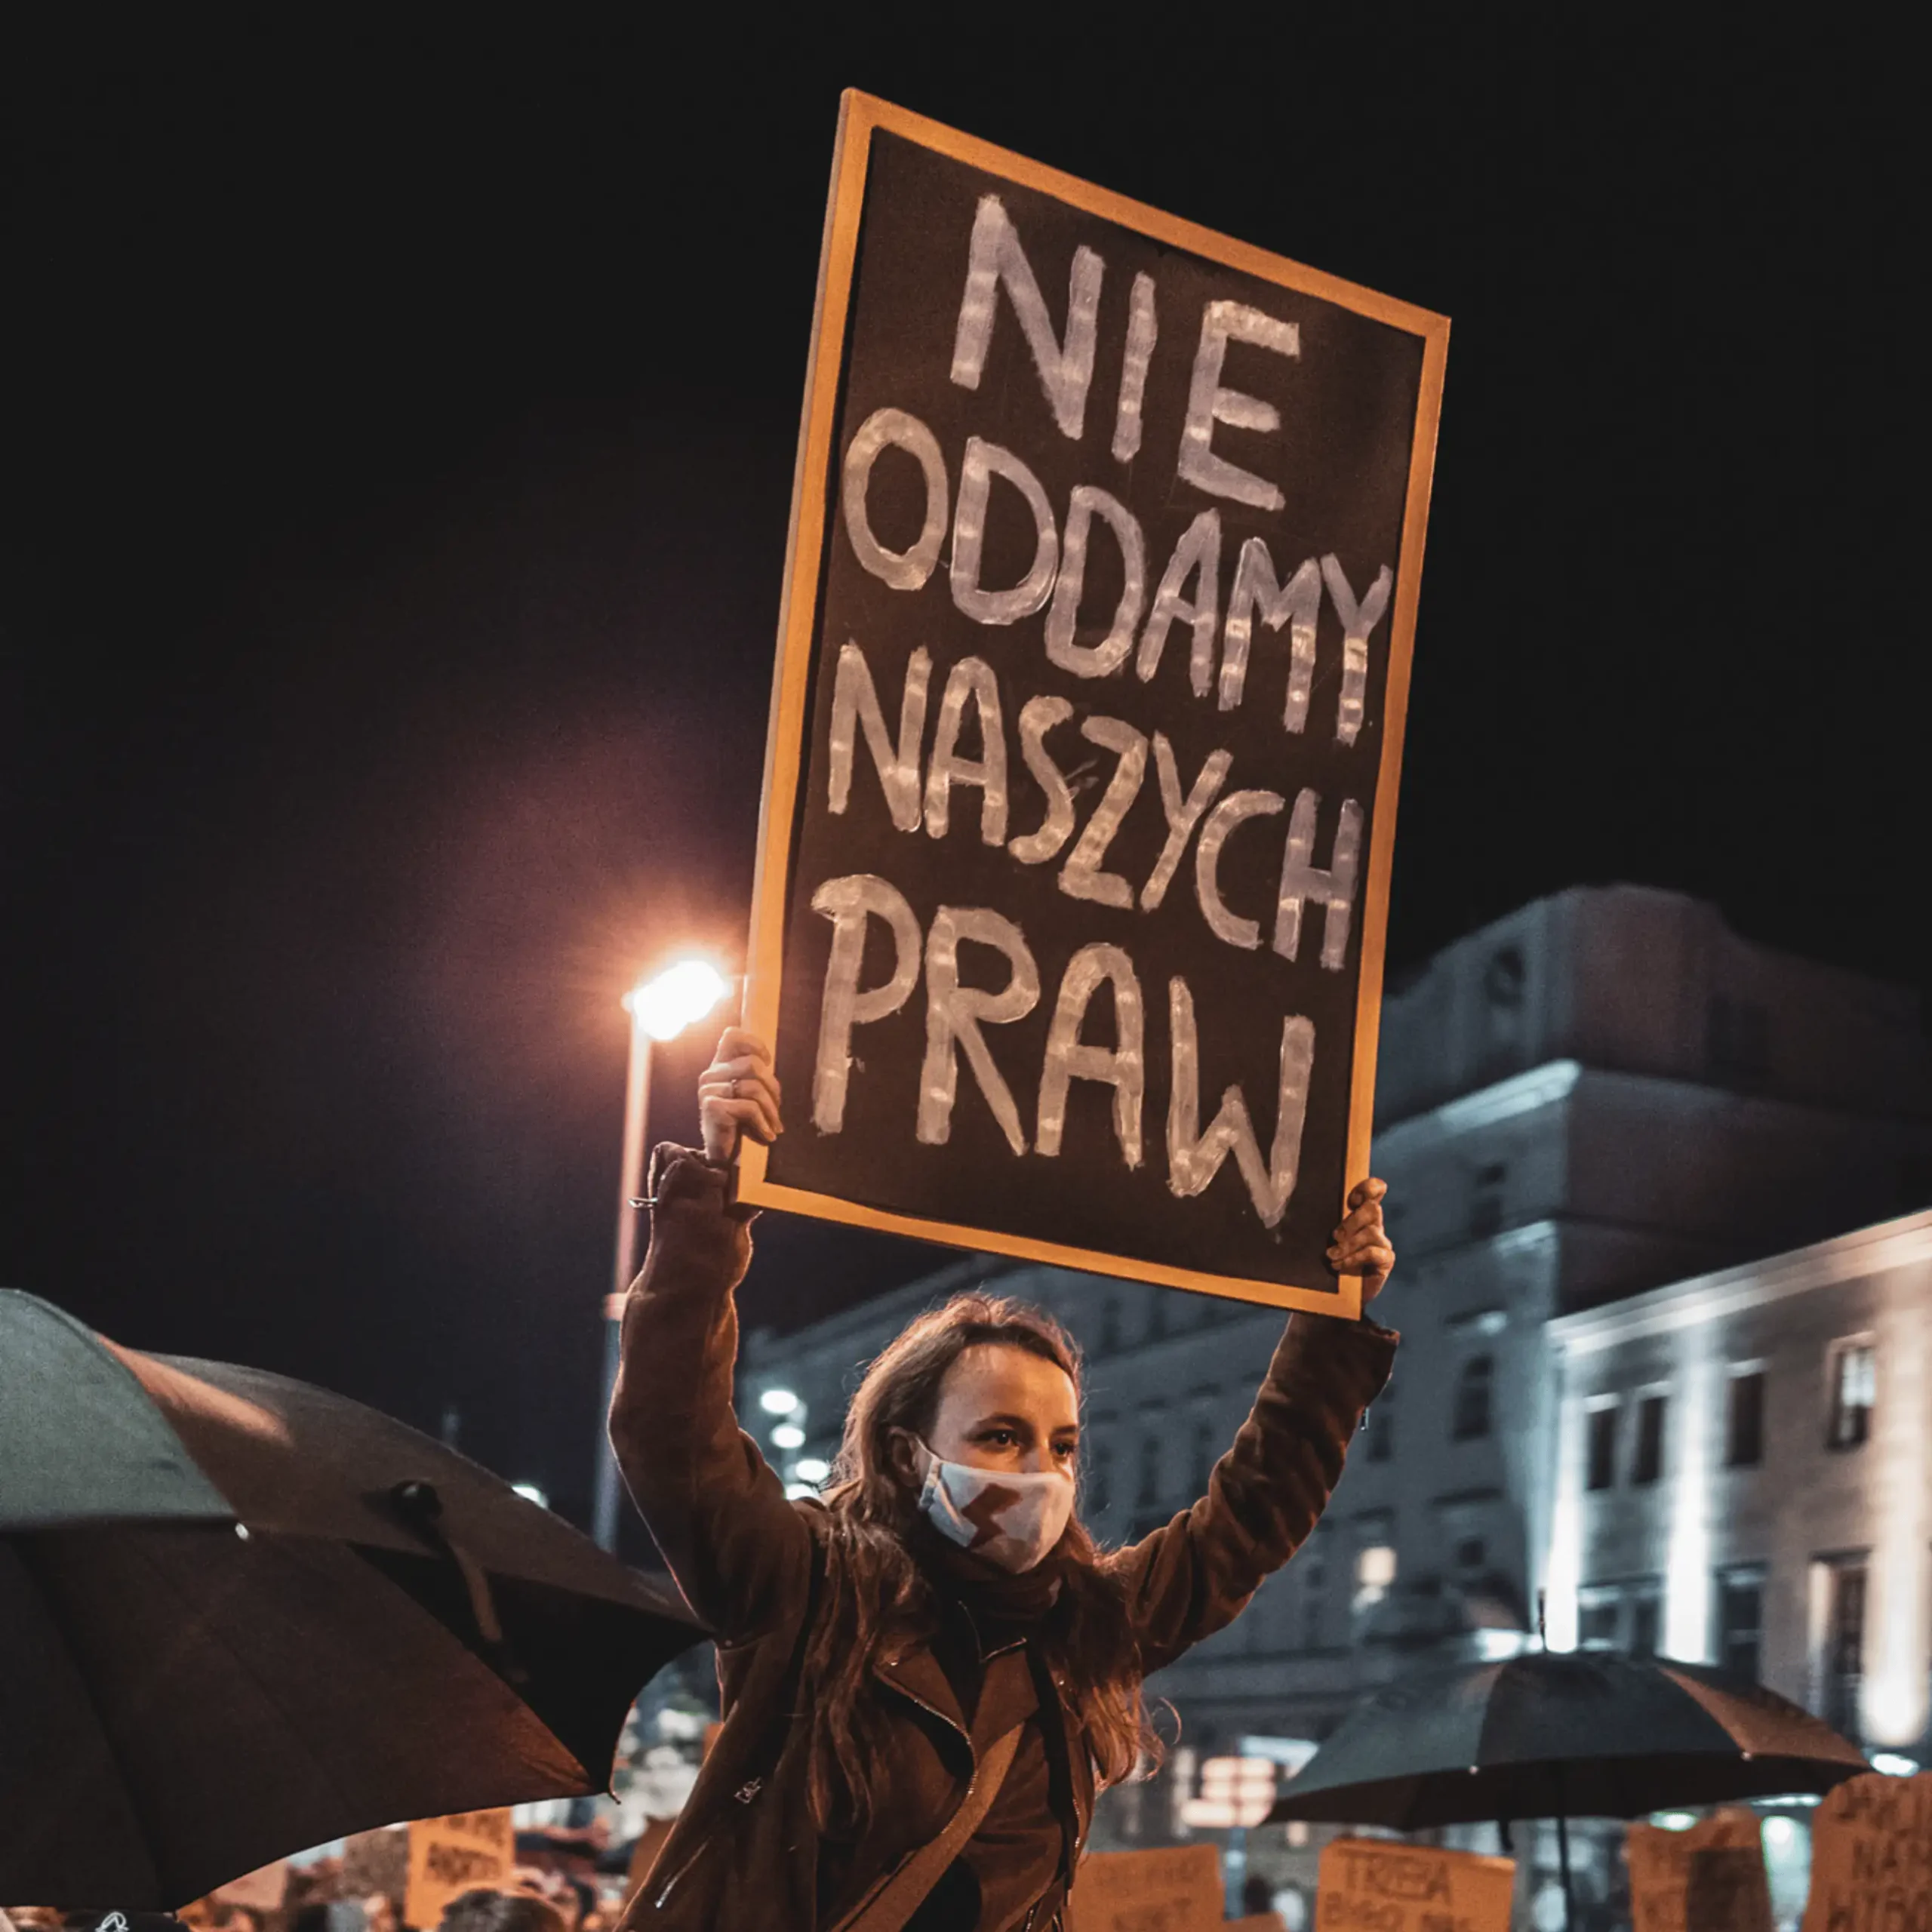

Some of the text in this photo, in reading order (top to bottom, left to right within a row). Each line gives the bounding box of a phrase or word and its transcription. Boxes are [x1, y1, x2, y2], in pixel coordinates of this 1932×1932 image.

[950, 195, 1300, 510] NIE
[843, 408, 1393, 746] ODDAMY
[829, 638, 1364, 971] NASZYCH
[811, 873, 1315, 1229] PRAW
